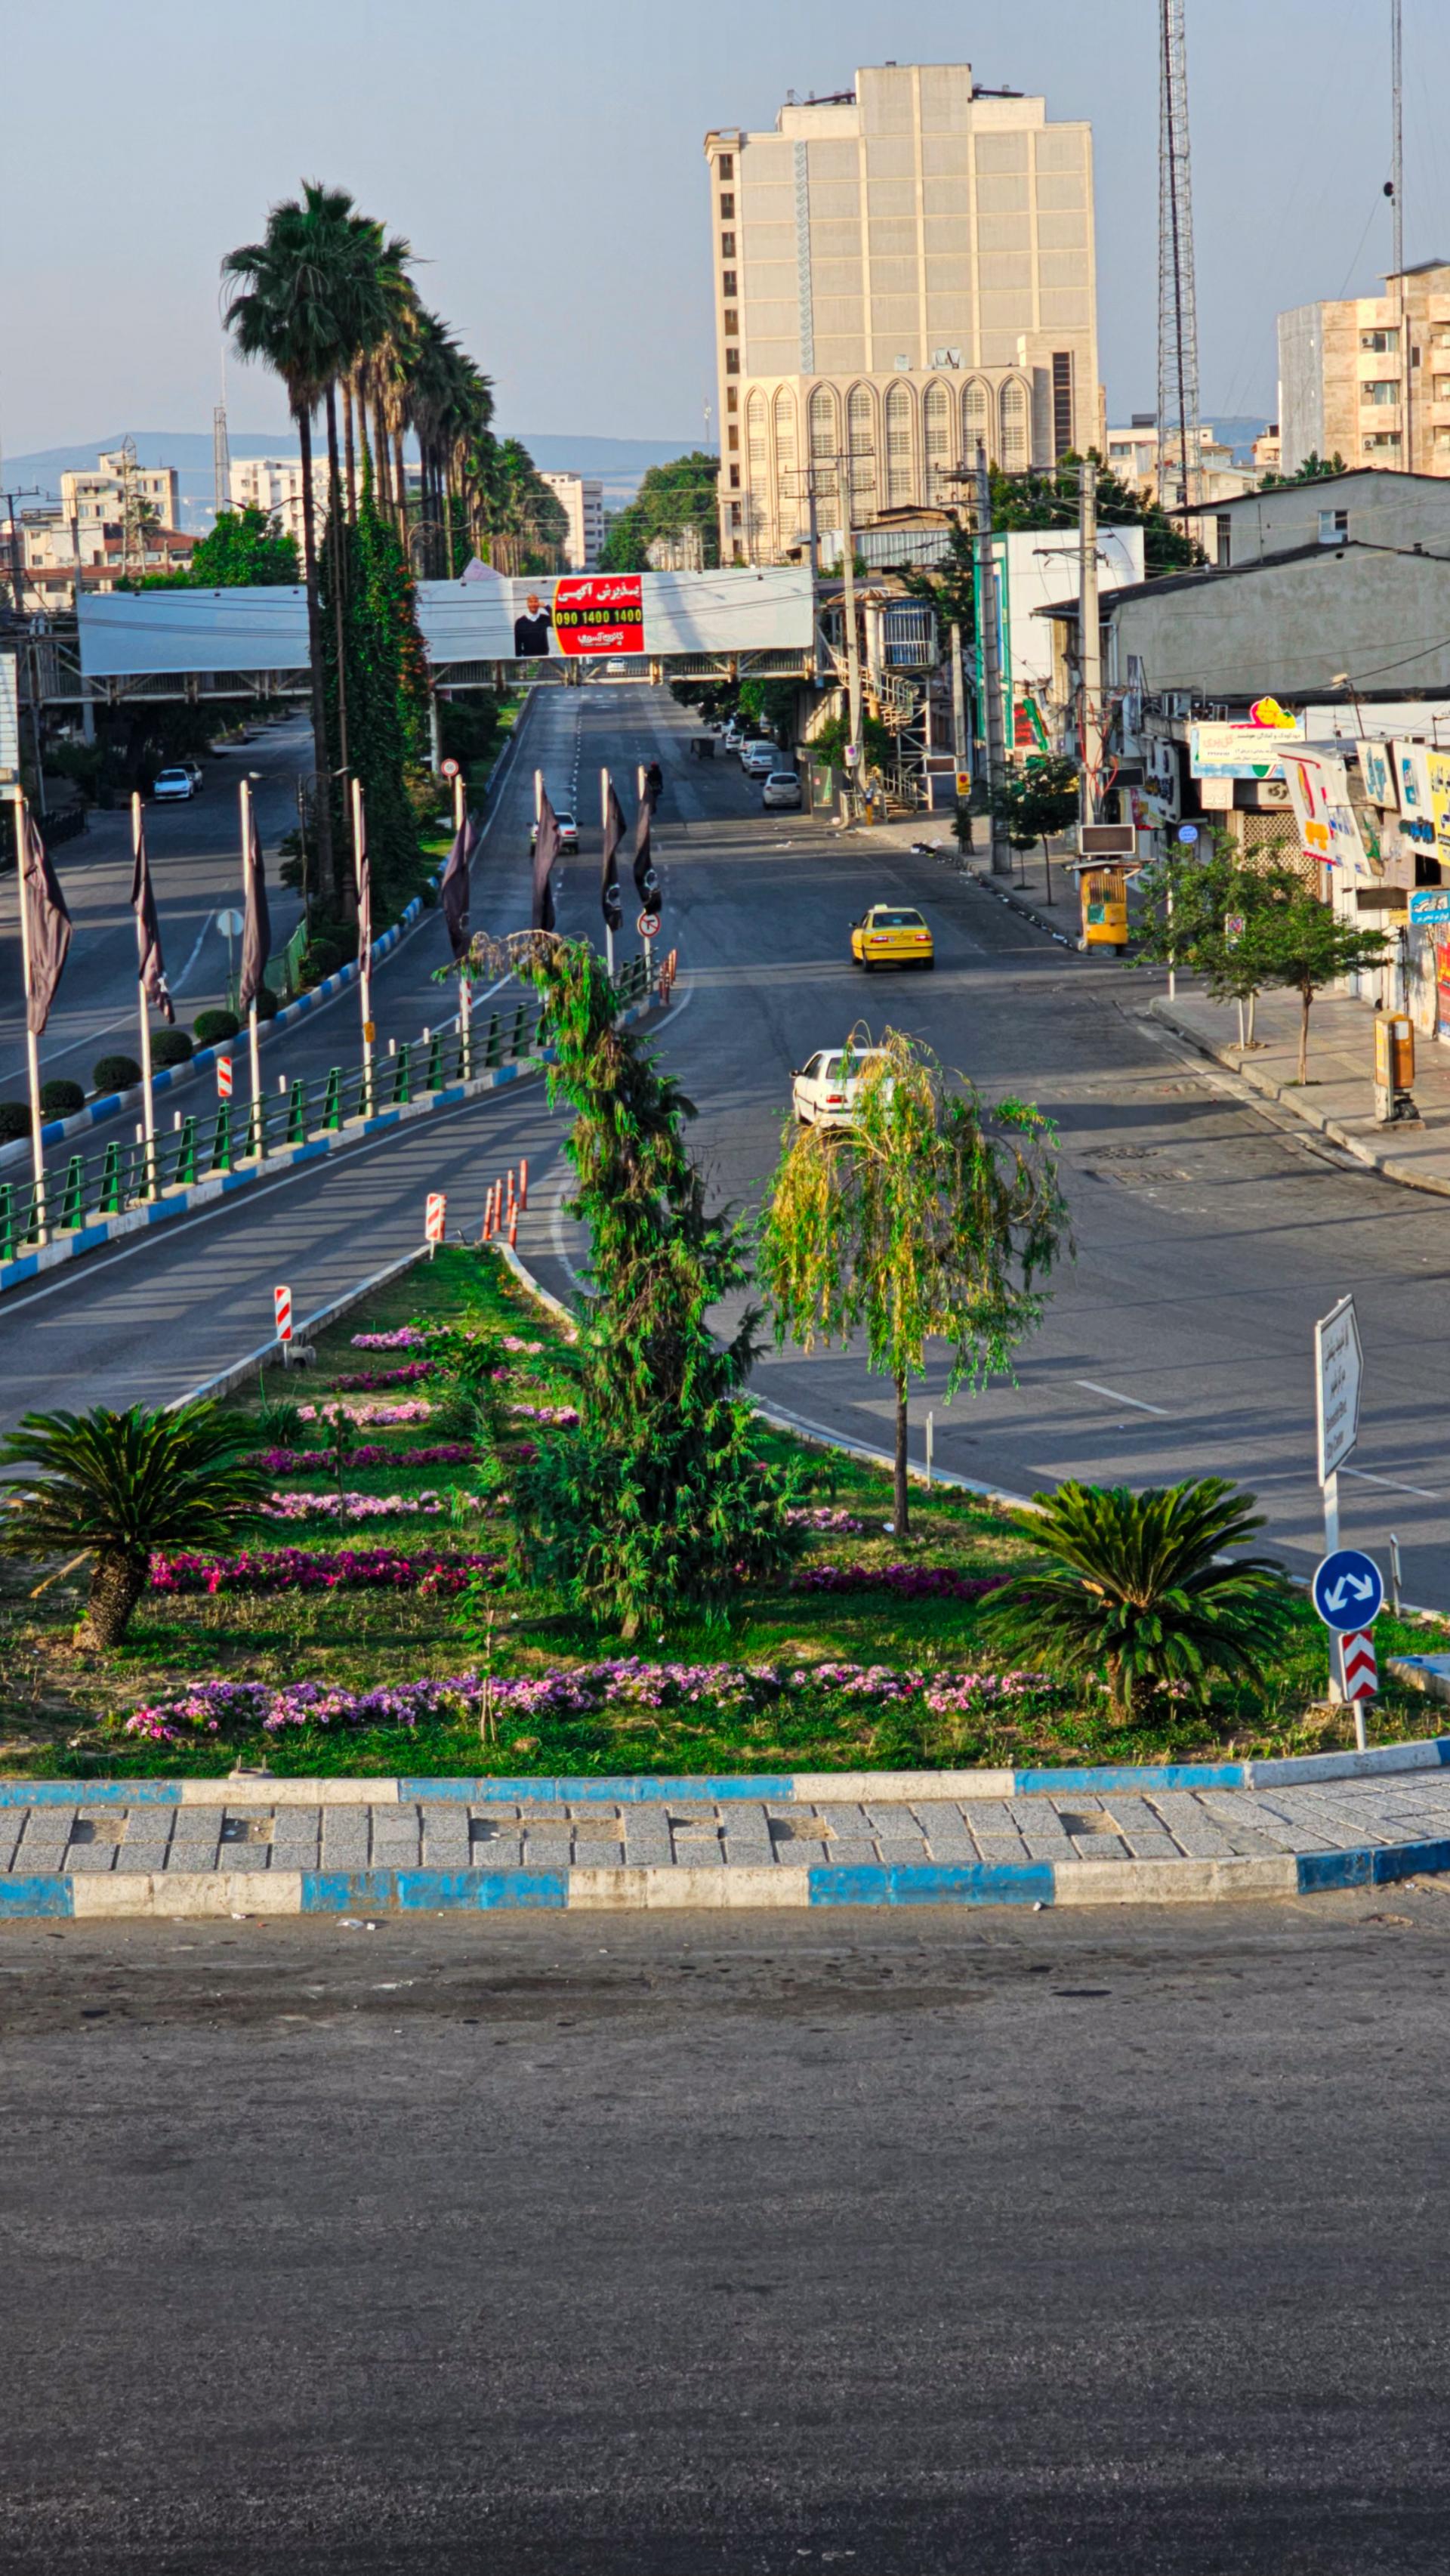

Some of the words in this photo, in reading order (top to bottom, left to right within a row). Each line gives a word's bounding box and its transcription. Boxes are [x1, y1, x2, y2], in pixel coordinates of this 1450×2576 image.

[558, 582, 593, 602] آگهی
[597, 582, 640, 601] پذیرش
[557, 613, 578, 625] 090
[582, 610, 610, 624] 1400
[614, 609, 642, 622] 1400
